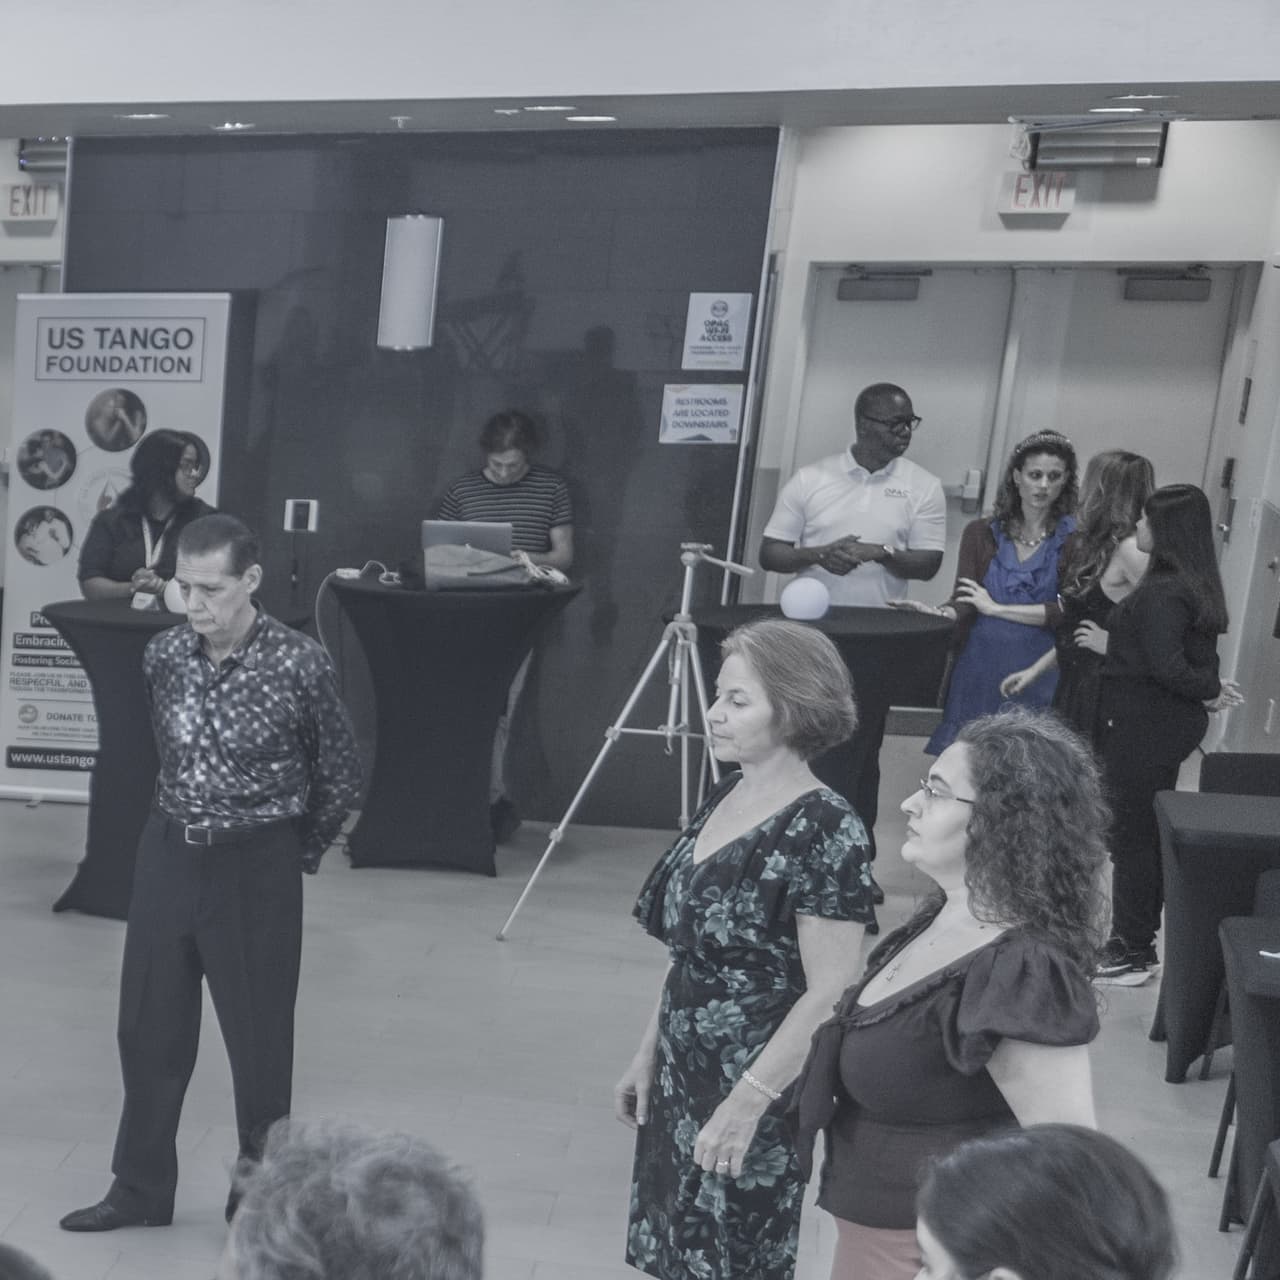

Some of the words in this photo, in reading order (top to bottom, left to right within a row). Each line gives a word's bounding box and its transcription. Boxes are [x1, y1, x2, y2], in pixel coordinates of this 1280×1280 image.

[1012, 173, 1066, 209] EXIT
[9, 184, 49, 216] EXIT
[47, 327, 84, 350] US
[94, 327, 194, 350] TANGO
[700, 334, 732, 342] ACCESS
[45, 355, 192, 374] FOUNDATION
[675, 398, 728, 406] RESTROOMS
[672, 409, 689, 417] ARE
[691, 409, 729, 417] LOCATED
[672, 421, 728, 429] DOWNSTAIRS
[15, 634, 71, 649] Embracin
[14, 655, 53, 667] Fostering
[67, 679, 88, 688] AND
[46, 712, 83, 722] DONATE
